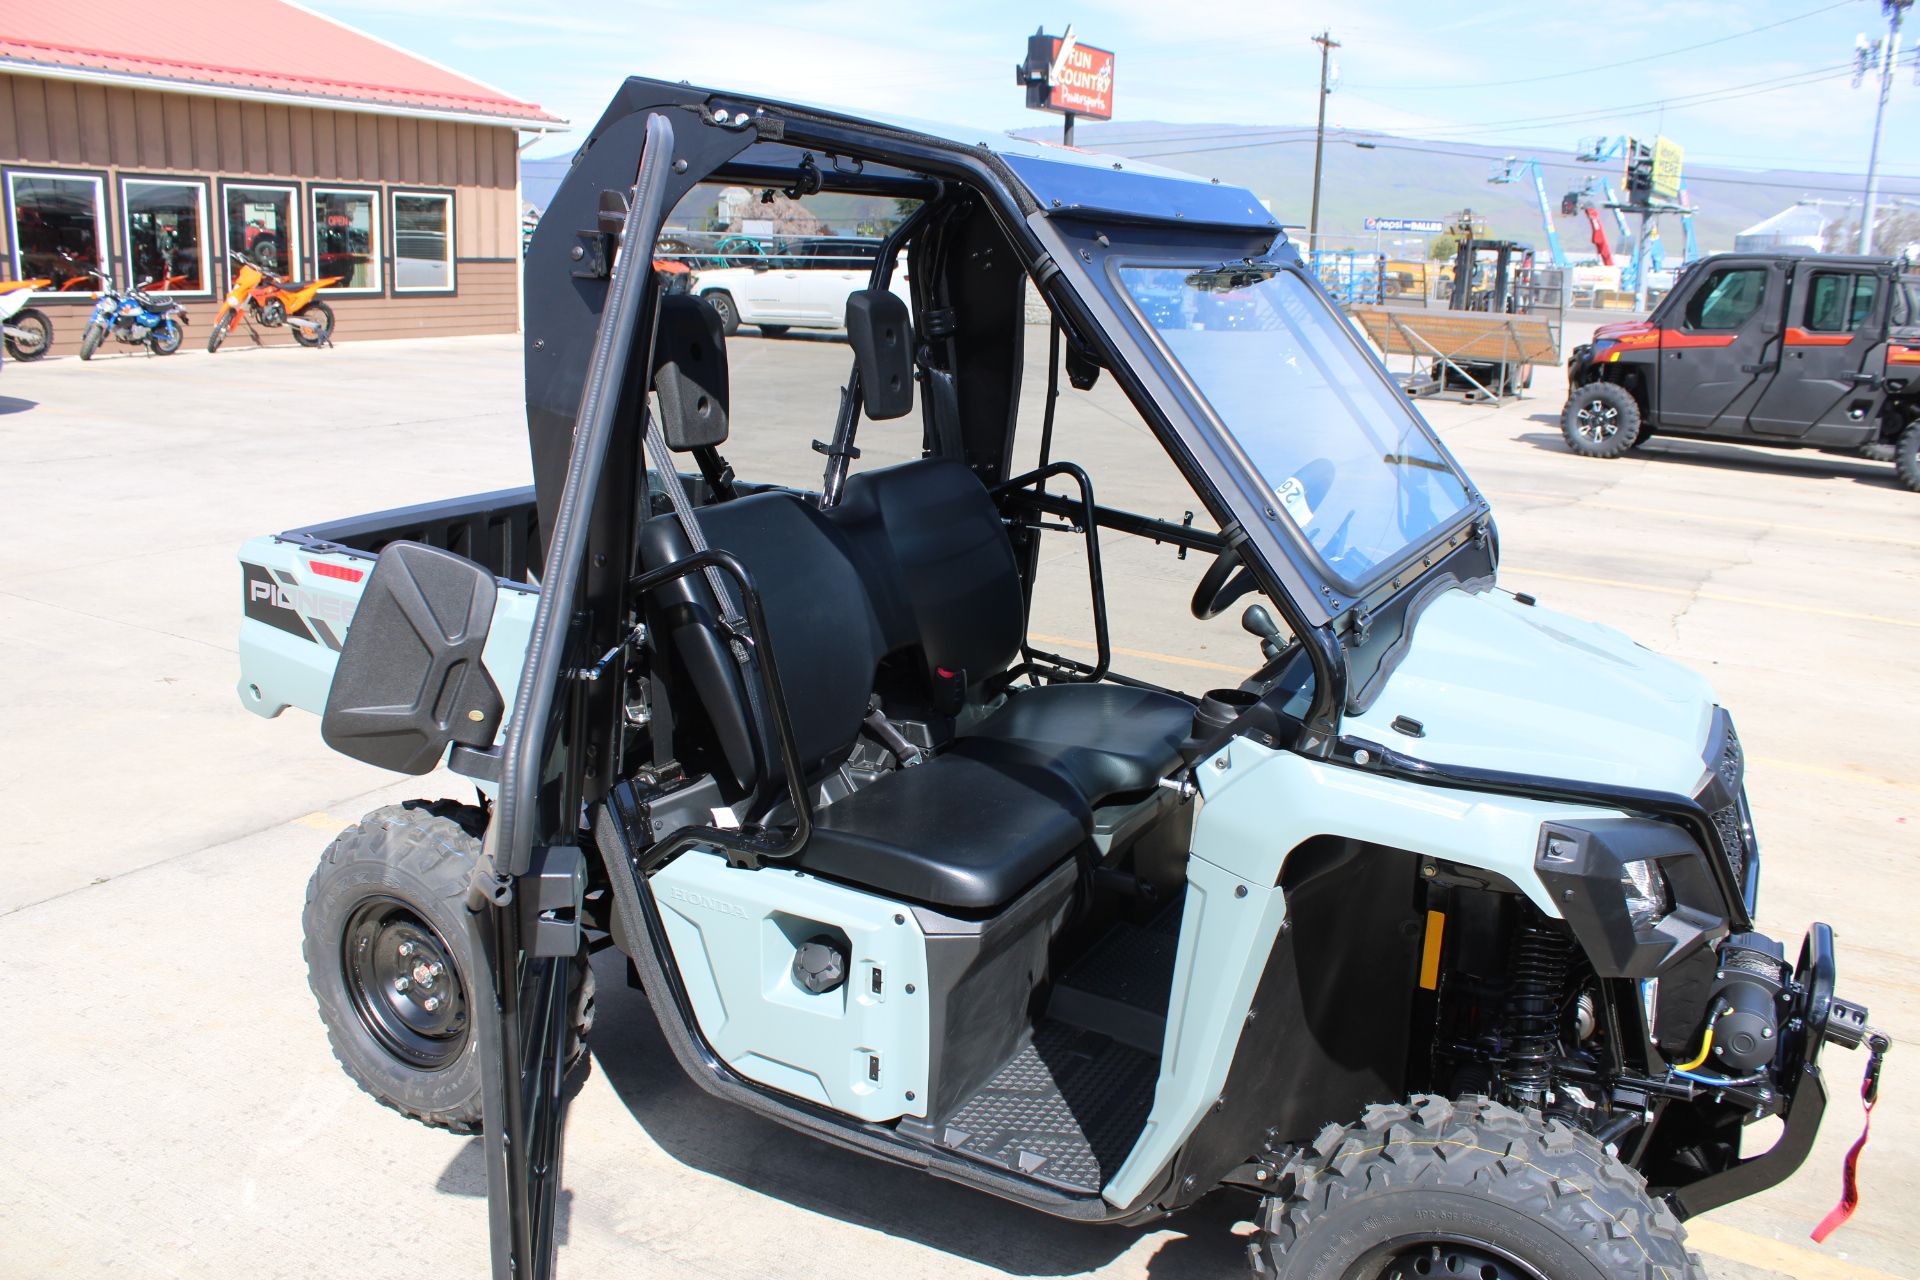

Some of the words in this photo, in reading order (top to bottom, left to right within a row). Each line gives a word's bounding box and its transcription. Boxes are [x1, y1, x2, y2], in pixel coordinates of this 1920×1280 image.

[1068, 48, 1092, 70] FUN
[1057, 65, 1112, 93] COUNTRY
[1061, 85, 1106, 112] Powersports
[328, 215, 349, 227] OPEN
[1376, 220, 1403, 231] pepsi
[250, 579, 355, 624] PIONEE
[671, 886, 749, 920] HONDA
